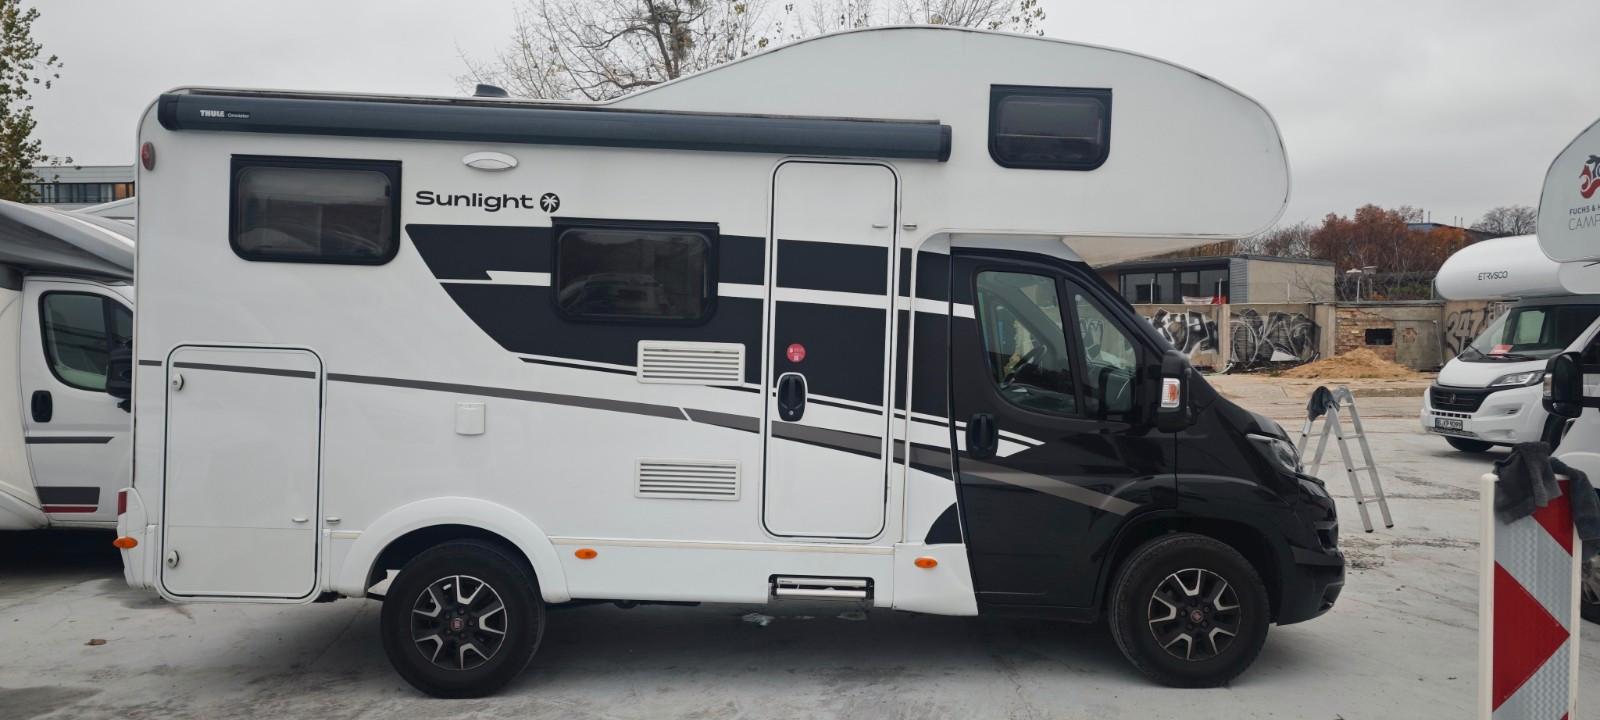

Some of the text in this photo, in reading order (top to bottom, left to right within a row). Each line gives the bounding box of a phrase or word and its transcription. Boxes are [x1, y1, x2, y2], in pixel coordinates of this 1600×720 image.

[199, 109, 225, 118] THULE
[415, 190, 534, 213] Sunlight
[1568, 205, 1590, 215] FUCHS
